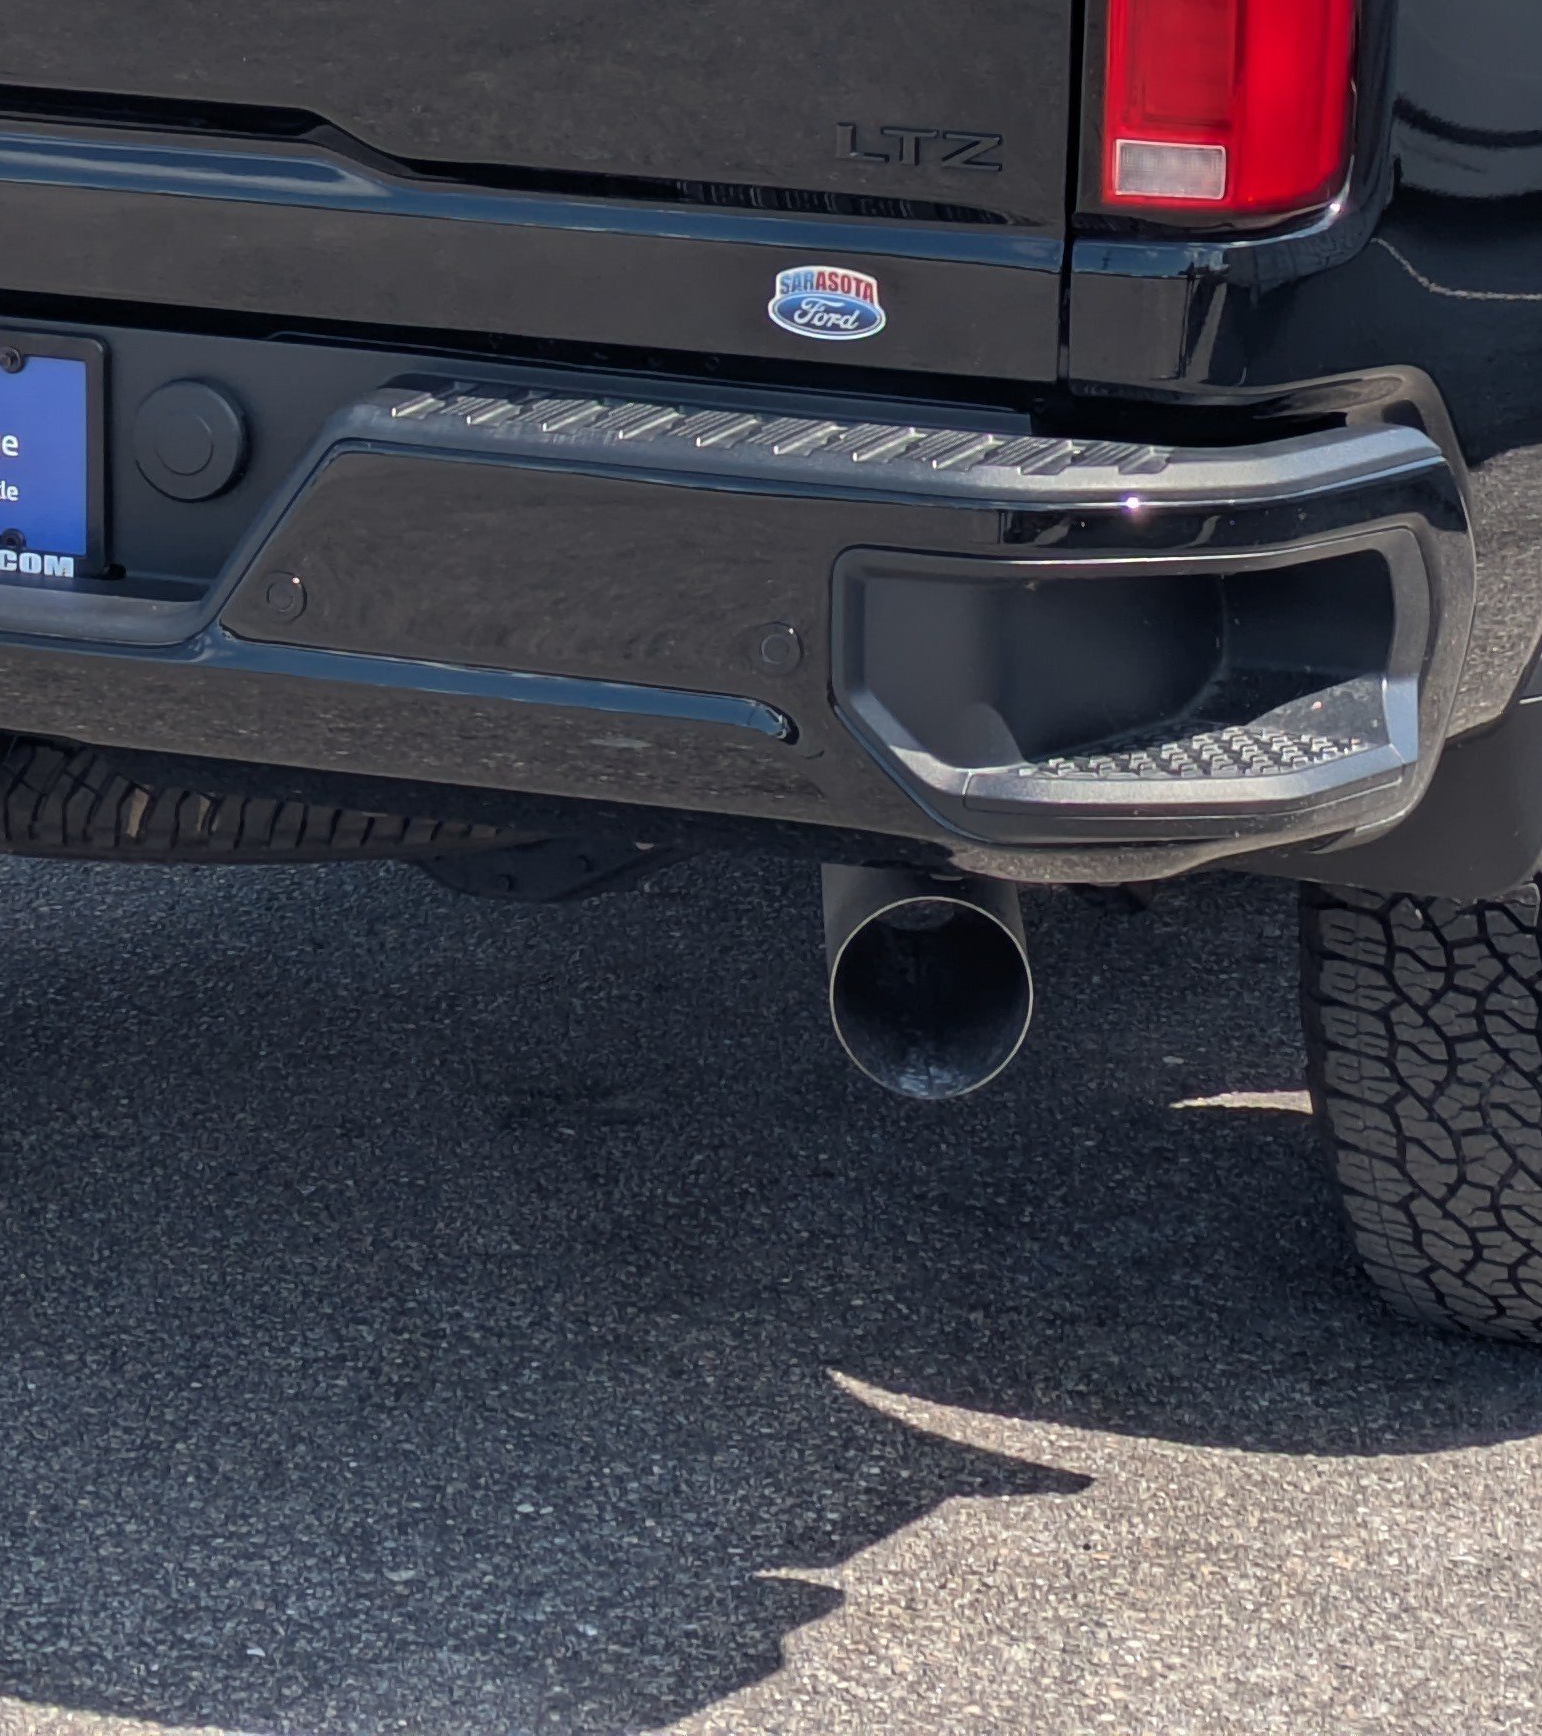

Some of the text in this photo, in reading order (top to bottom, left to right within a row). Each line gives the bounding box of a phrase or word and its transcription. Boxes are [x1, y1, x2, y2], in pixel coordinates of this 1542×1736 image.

[835, 121, 1003, 171] LTZ
[779, 270, 874, 304] SARASOTA
[793, 297, 860, 330] Ford
